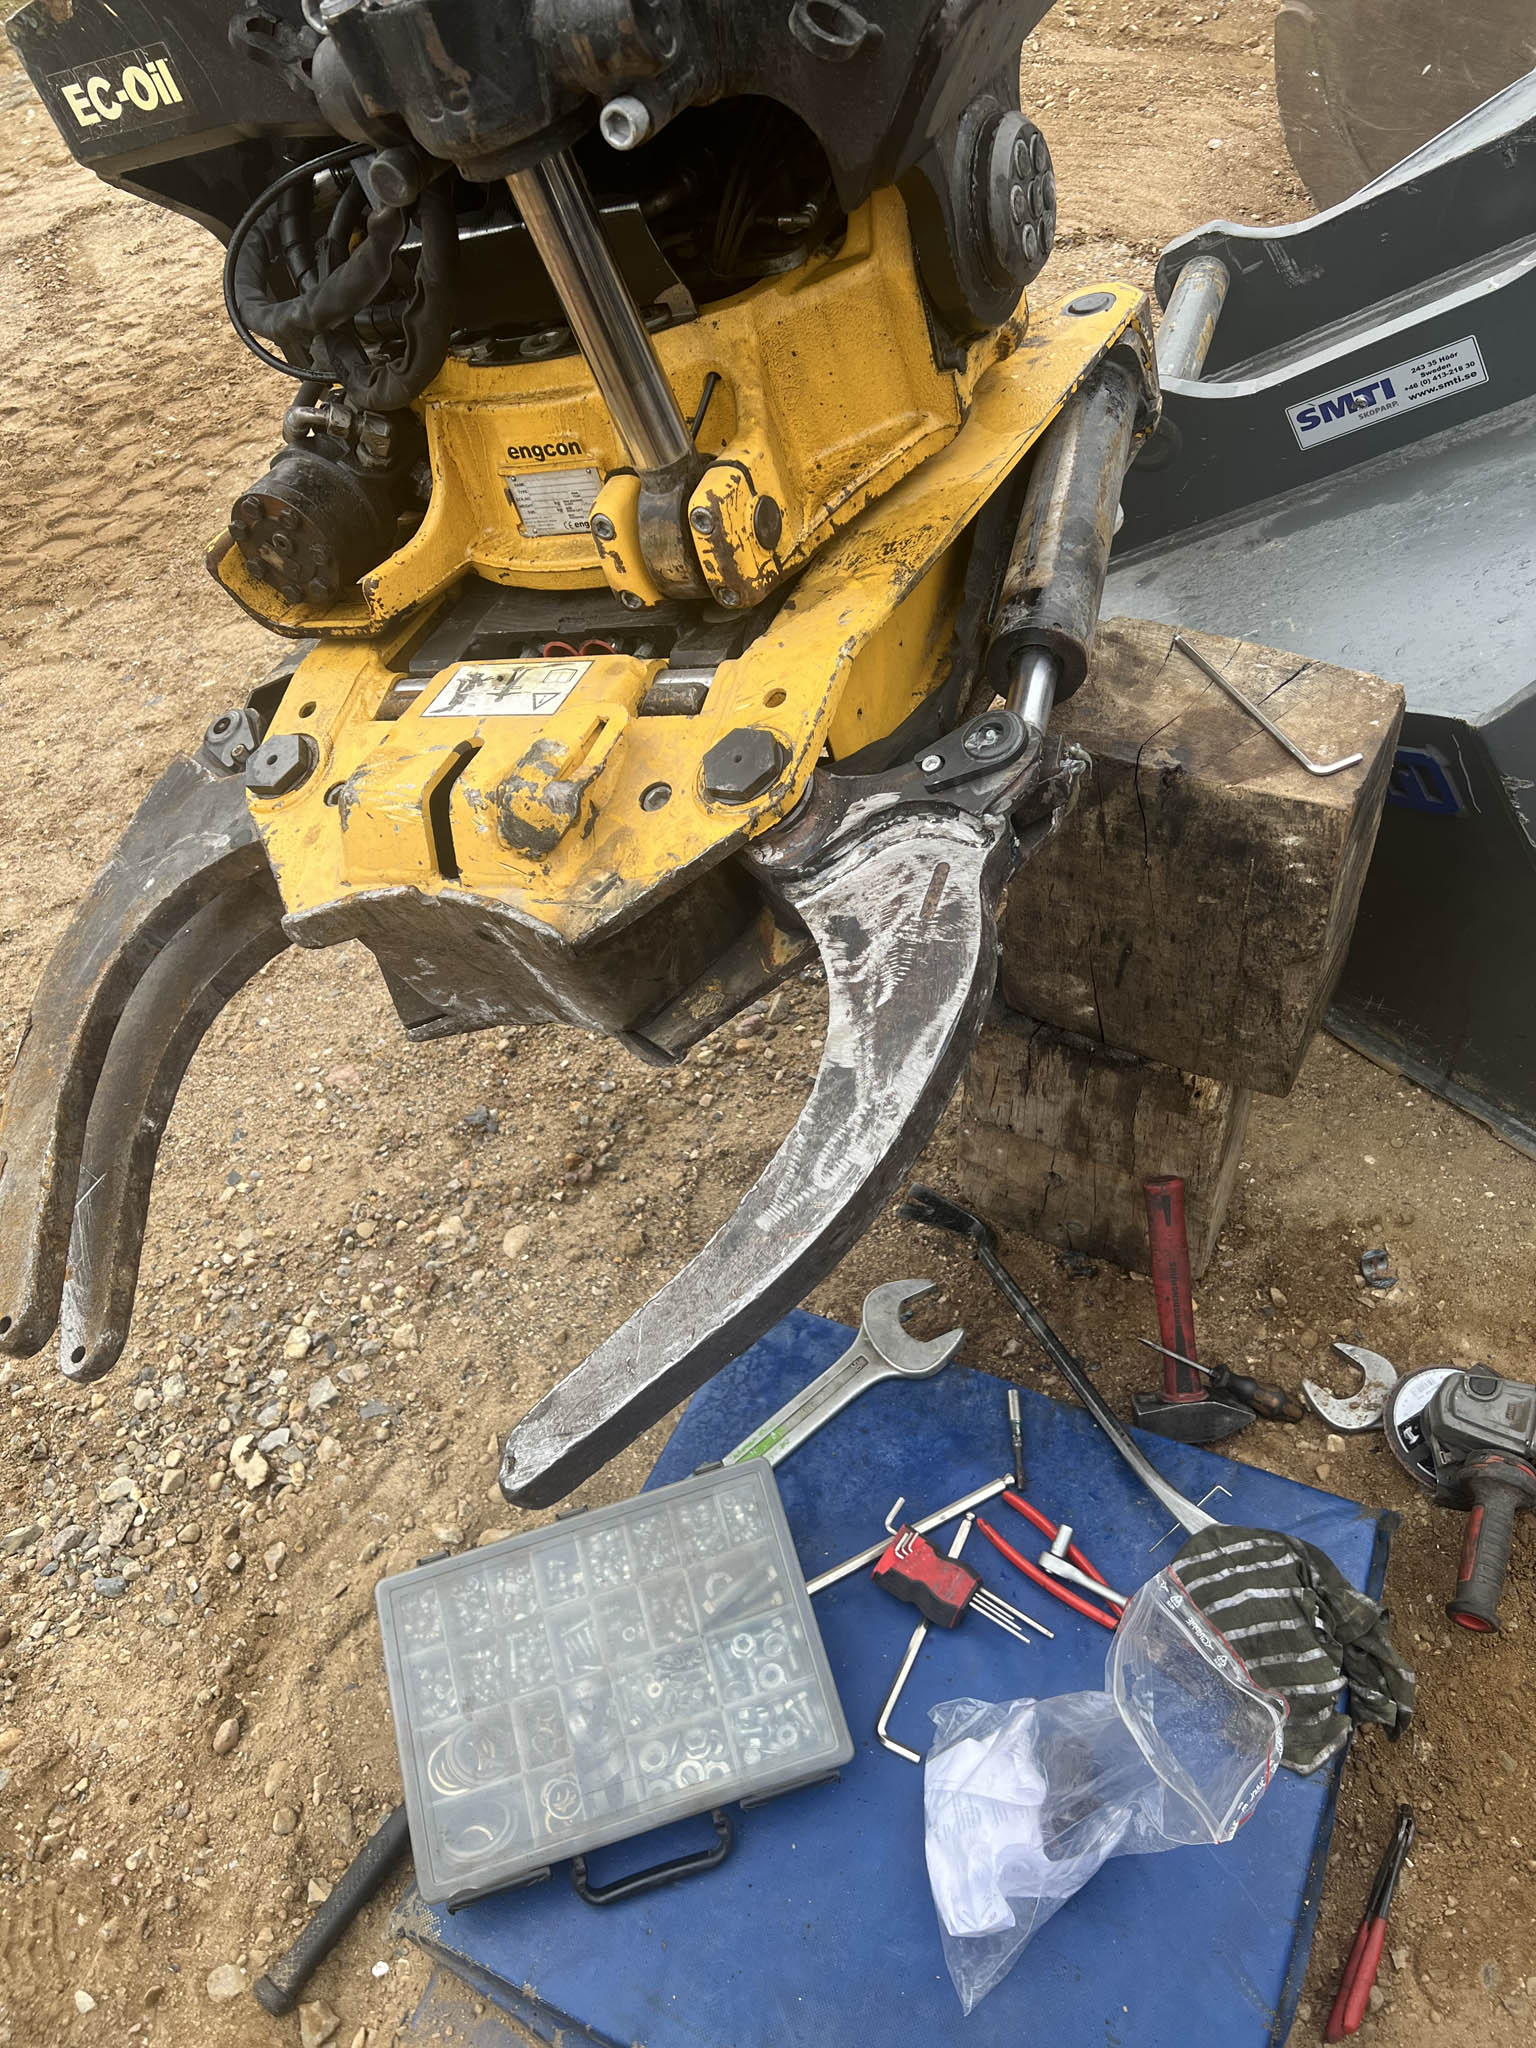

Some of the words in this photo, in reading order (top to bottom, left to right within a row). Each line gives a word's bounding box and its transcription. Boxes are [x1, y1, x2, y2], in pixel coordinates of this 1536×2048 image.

[60, 58, 184, 127] EC-Oil
[1410, 364, 1426, 374] 243
[1426, 360, 1438, 368] 35
[1420, 363, 1452, 378] Sweden
[1420, 378, 1431, 388] (0)
[1432, 365, 1464, 381] 413-218
[1465, 361, 1476, 369] 30
[1408, 371, 1478, 401] www.smti.se
[1296, 377, 1396, 432] SMTI
[507, 441, 583, 462] engcon
